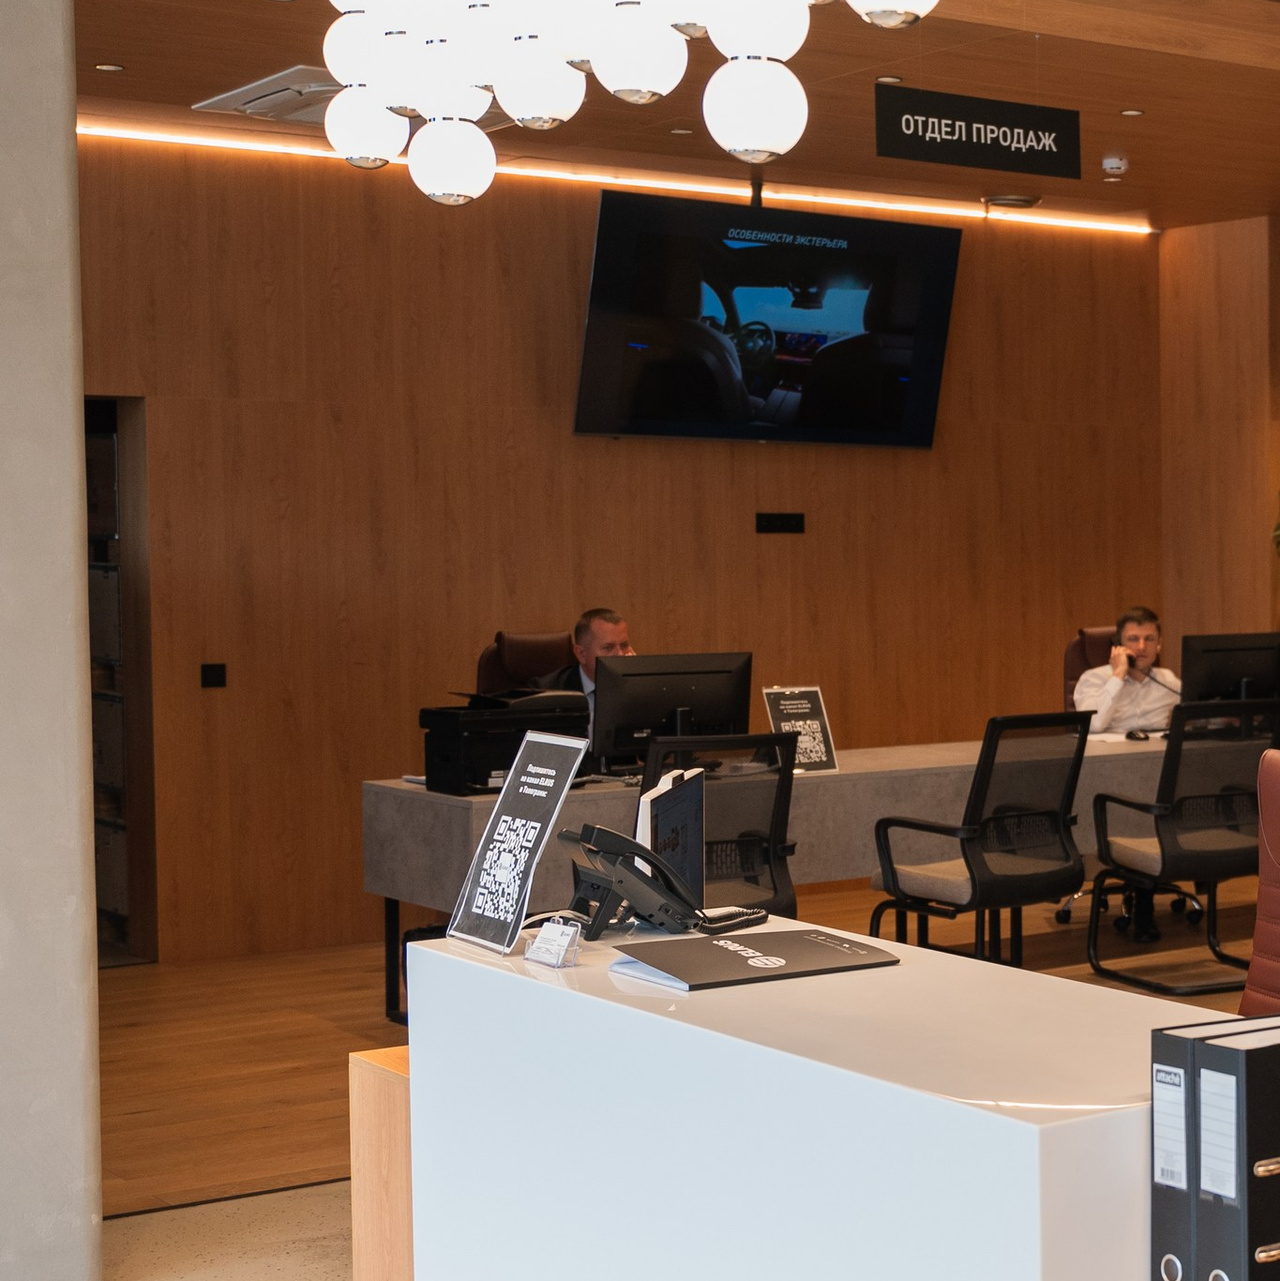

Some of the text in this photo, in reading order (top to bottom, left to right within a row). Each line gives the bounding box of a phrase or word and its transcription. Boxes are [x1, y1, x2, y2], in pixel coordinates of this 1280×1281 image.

[901, 114, 1058, 152] ОТДЕЛ ПРОДАЖ
[728, 228, 848, 249] ОСОБЕННОСТИ ЭКСТЕРЬЕРА
